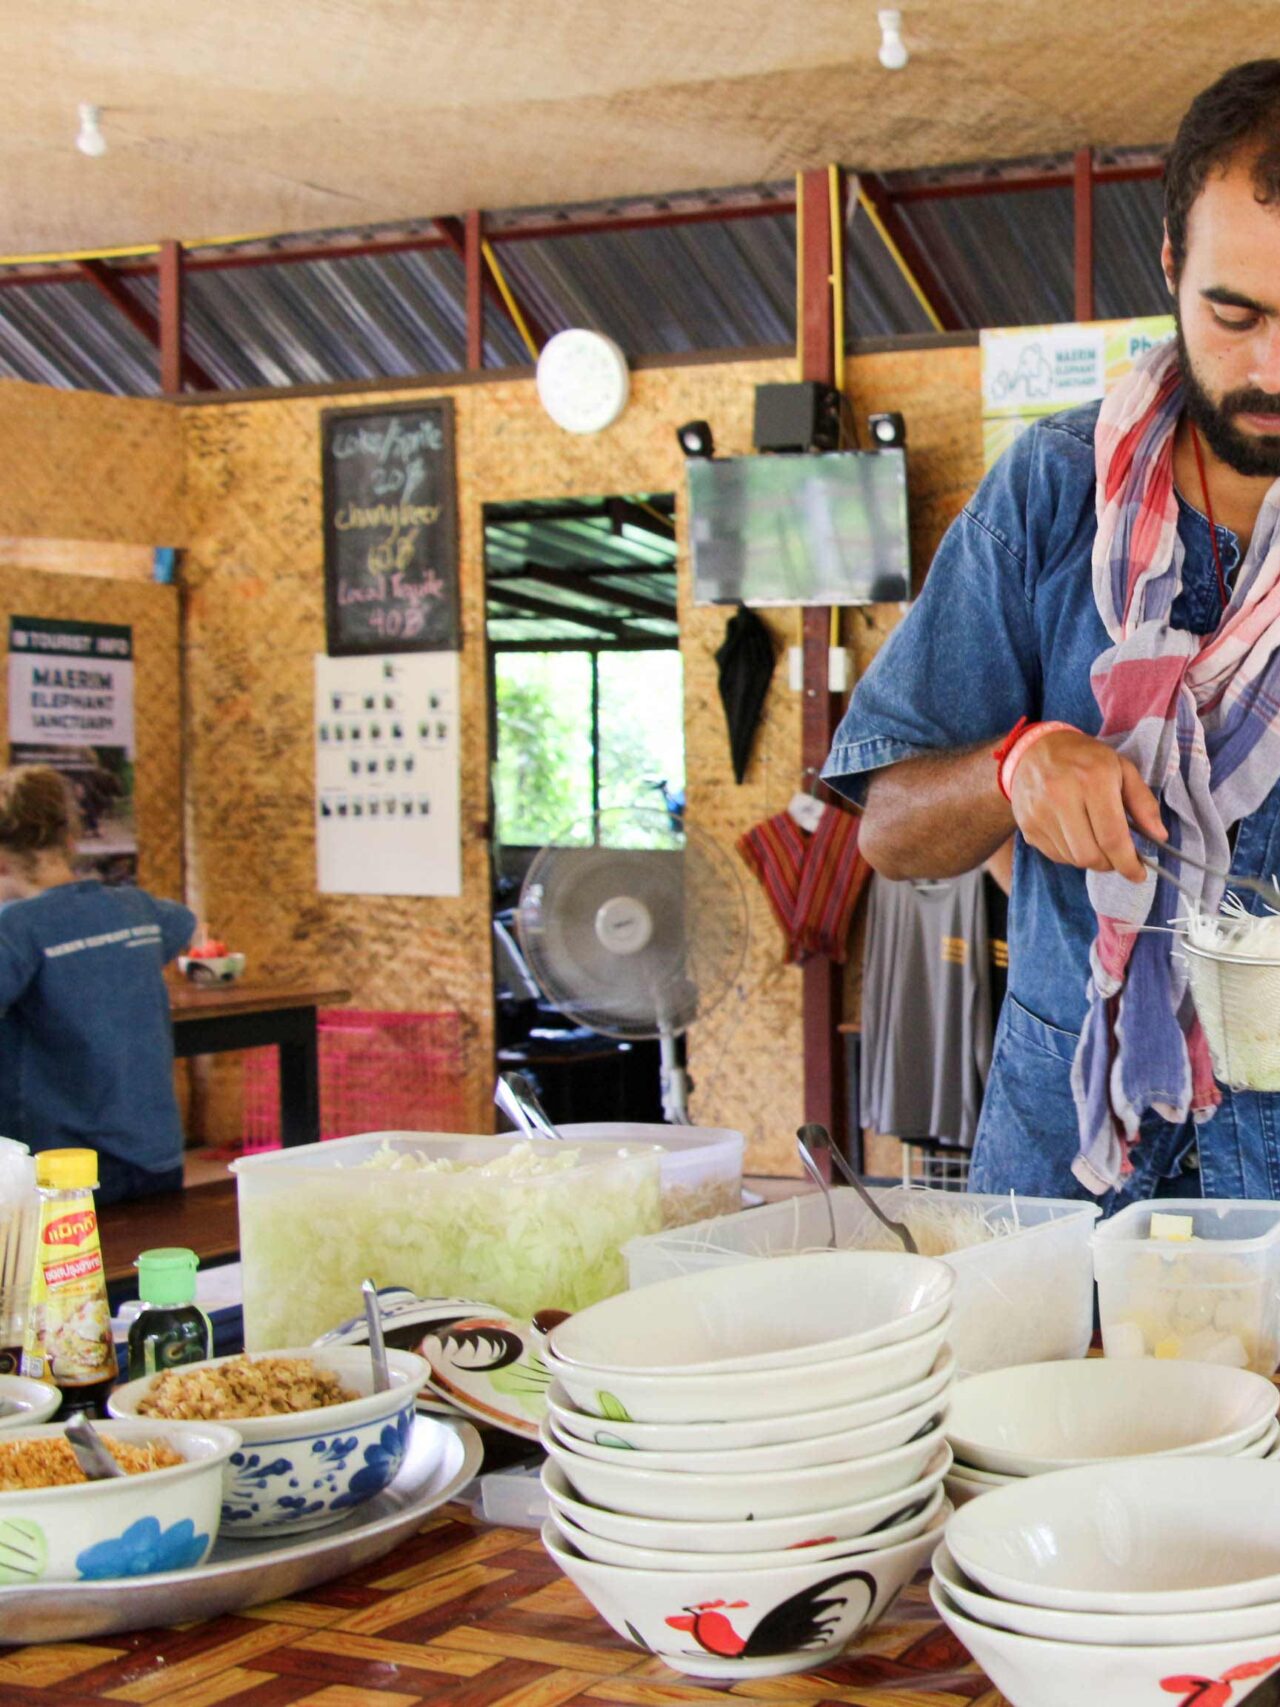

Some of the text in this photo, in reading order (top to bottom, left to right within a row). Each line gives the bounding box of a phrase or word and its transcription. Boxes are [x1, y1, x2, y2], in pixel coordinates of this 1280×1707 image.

[32, 667, 114, 691] MAERIM
[31, 692, 114, 710] ELEPHANT
[32, 713, 114, 729] SANCTUARY
